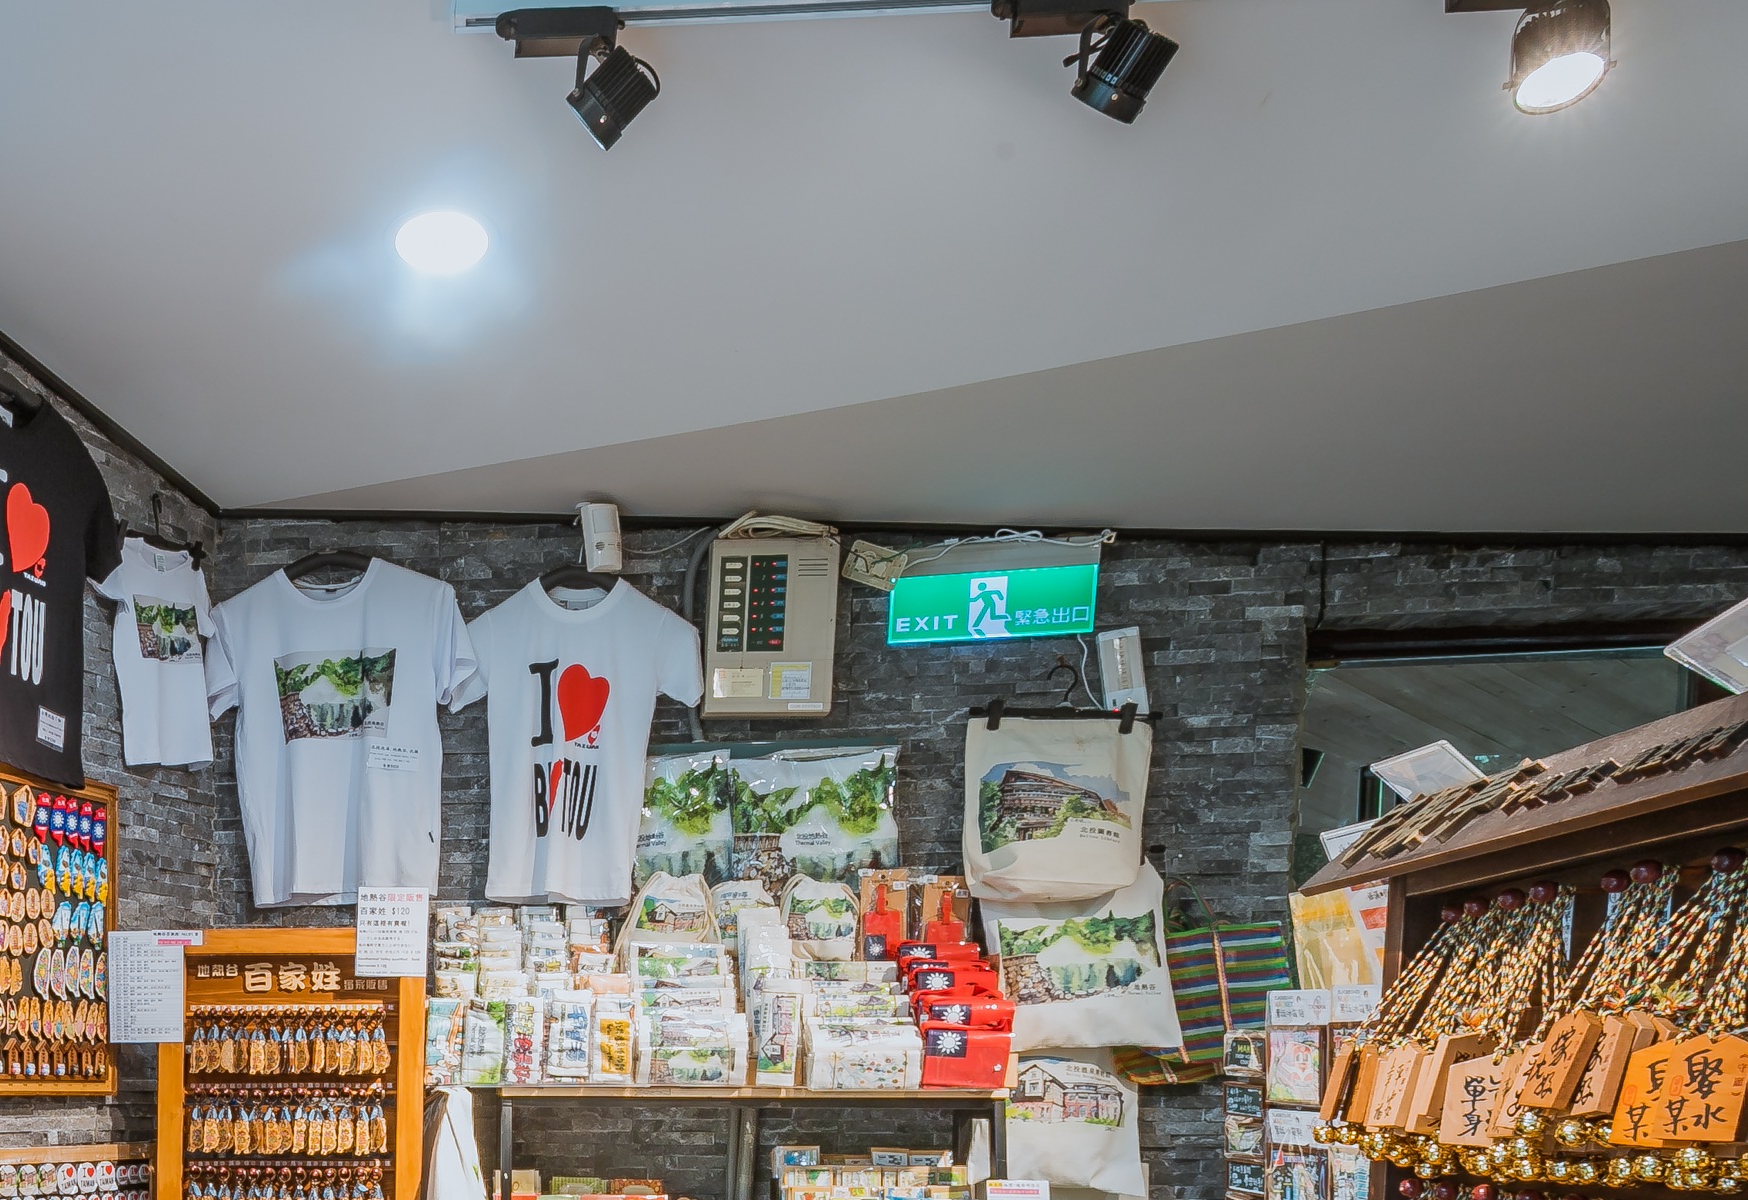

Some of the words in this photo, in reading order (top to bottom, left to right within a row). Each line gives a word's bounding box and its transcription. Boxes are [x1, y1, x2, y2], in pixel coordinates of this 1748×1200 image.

[1015, 605, 1089, 626] 緊急出口
[896, 615, 958, 633] EXIT
[528, 658, 559, 747] I
[360, 893, 424, 902] 地熱谷限定販售
[360, 907, 386, 915] 百家姓
[391, 907, 410, 915] $120
[197, 964, 238, 978] 地熱谷
[245, 961, 342, 993] 百家姓
[343, 978, 388, 991] 獨家販售
